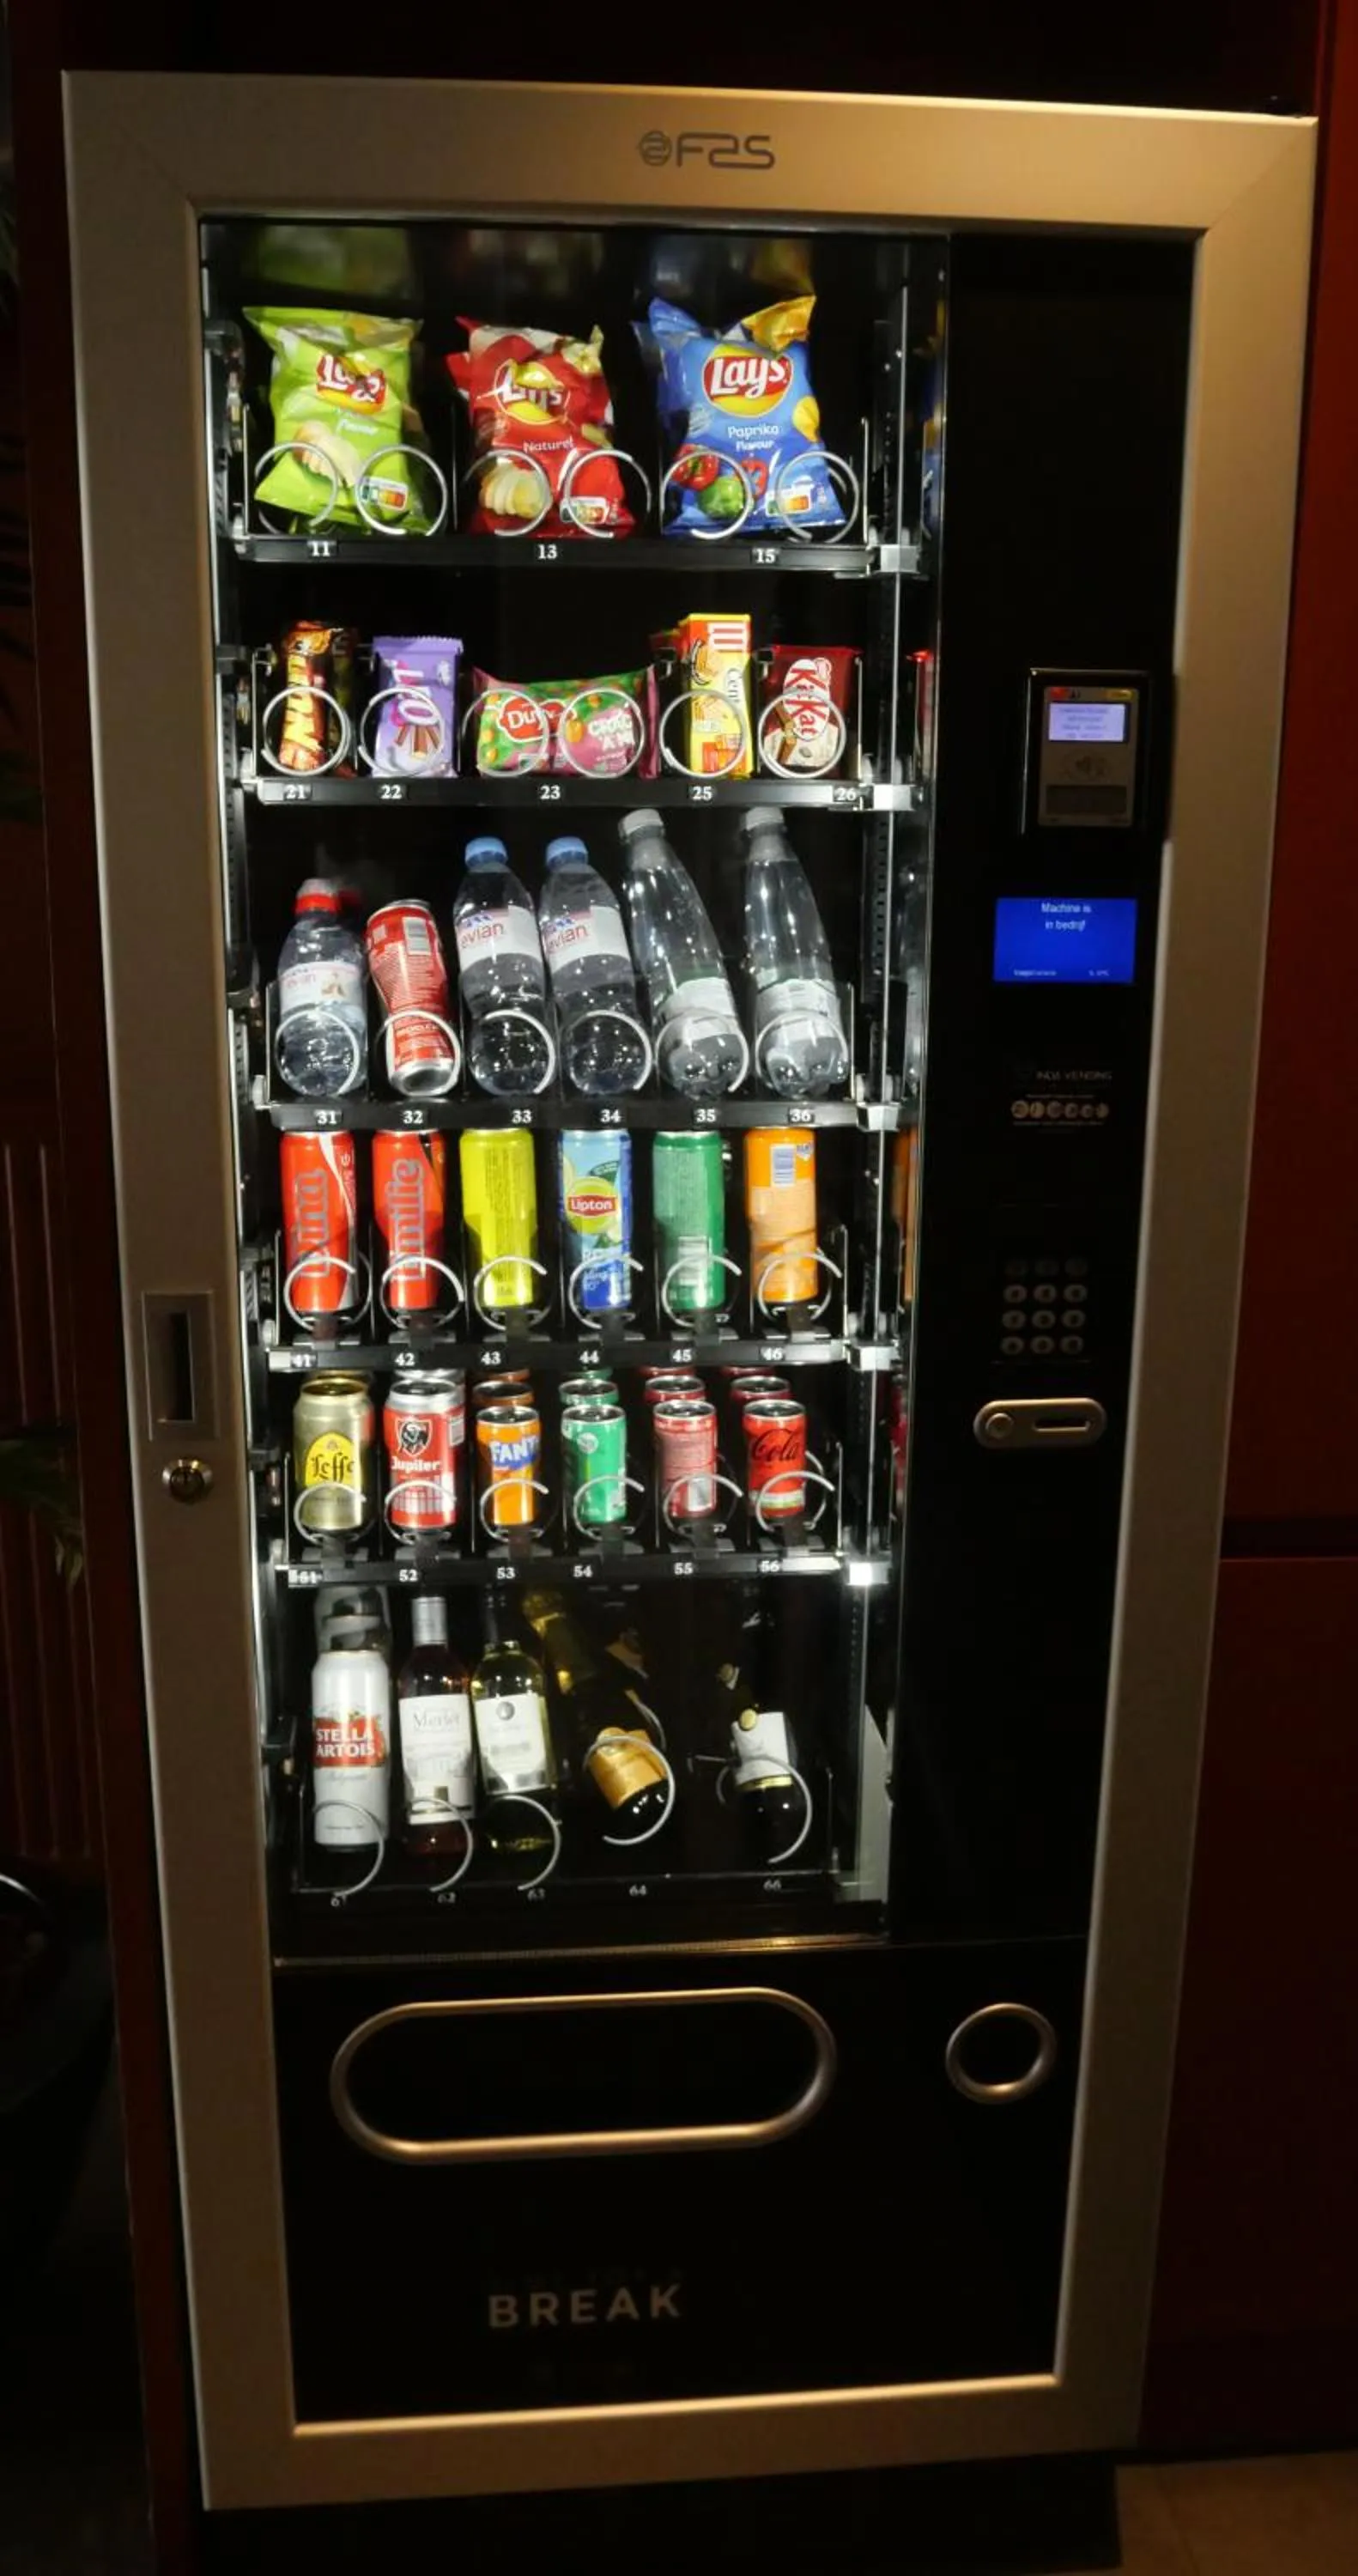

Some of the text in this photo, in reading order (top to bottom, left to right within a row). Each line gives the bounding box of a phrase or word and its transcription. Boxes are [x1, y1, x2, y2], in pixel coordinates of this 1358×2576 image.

[728, 422, 779, 440] Paprika
[523, 437, 573, 453] Naturel
[312, 543, 330, 557] 11
[537, 544, 558, 559] 13
[755, 548, 776, 563] 15
[286, 785, 306, 799] 21
[380, 786, 403, 799] 22
[540, 785, 561, 799] 23
[693, 787, 712, 800] 25
[836, 787, 857, 801] 26
[317, 1110, 337, 1124] 31
[403, 1110, 423, 1124] 32
[512, 1109, 532, 1123] 33
[601, 1109, 621, 1123] 34
[696, 1108, 717, 1122] 35
[790, 1109, 811, 1122] 36
[570, 1197, 613, 1212] Lipton
[291, 1353, 312, 1367] 41
[395, 1352, 415, 1366] 42
[481, 1351, 501, 1365] 43
[580, 1350, 599, 1364] 44
[673, 1348, 692, 1362] 45
[763, 1347, 783, 1361] 46
[490, 1436, 539, 1463] FANT
[573, 1565, 593, 1578] 54
[674, 1562, 694, 1575] 55
[761, 1560, 780, 1572] 56
[301, 1571, 318, 1584] 51
[398, 1569, 417, 1583] 52
[496, 1567, 515, 1580] 53
[316, 1728, 374, 1743] STELLA
[316, 1742, 375, 1758] ARTOIS
[629, 1885, 647, 1897] 64
[763, 1880, 782, 1891] 66
[488, 2284, 682, 2329] BREAK
